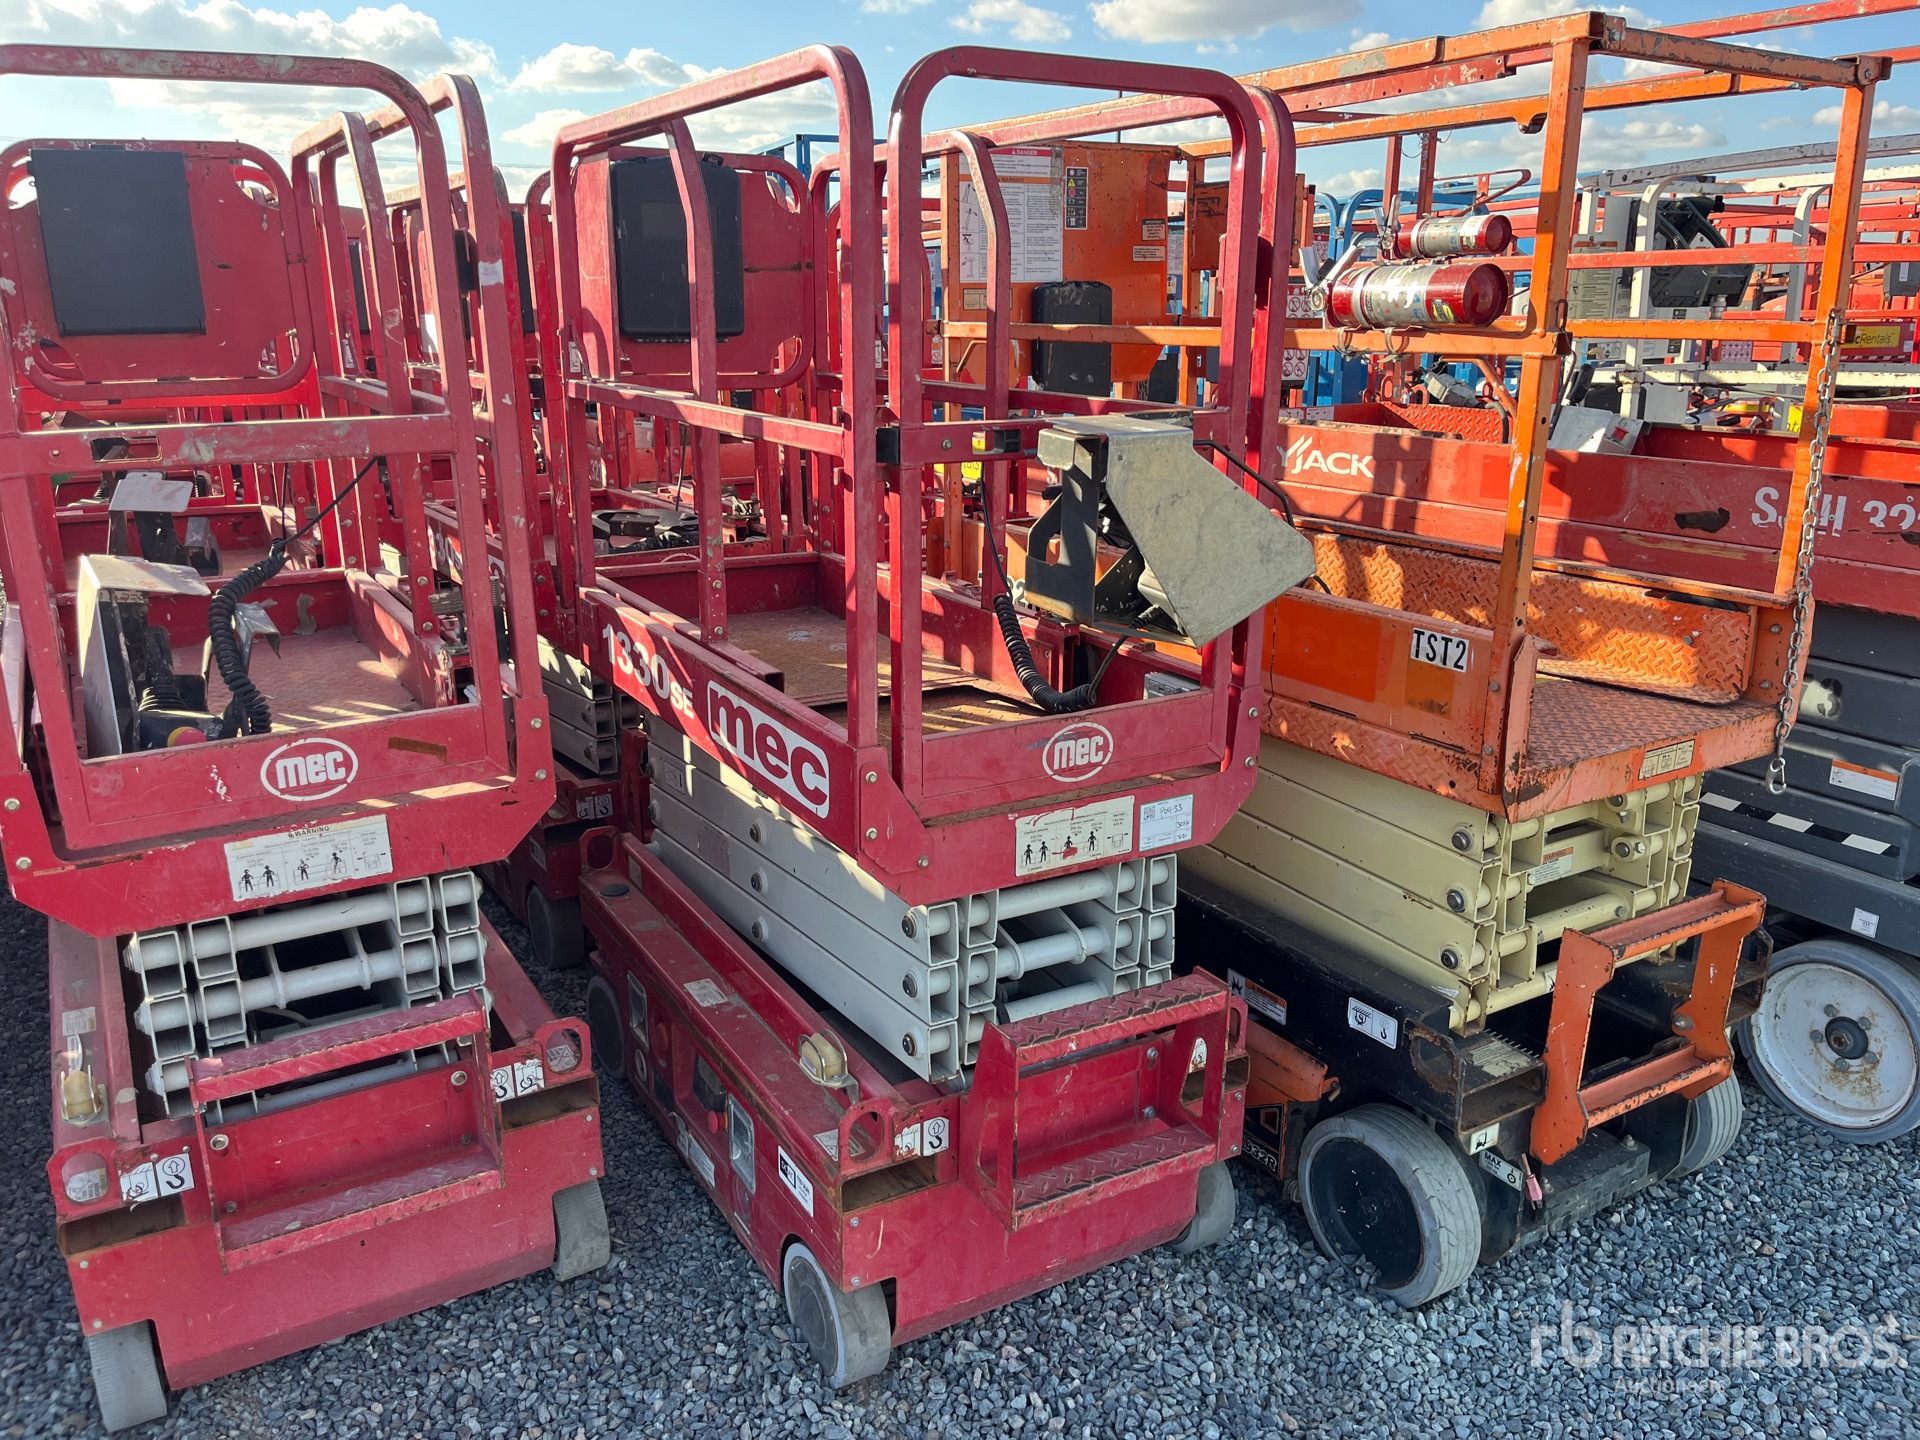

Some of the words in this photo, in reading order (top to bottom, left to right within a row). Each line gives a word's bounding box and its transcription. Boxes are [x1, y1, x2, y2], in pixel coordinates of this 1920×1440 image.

[1276, 434, 1375, 479] YJACK
[1413, 629, 1466, 670] TST2
[709, 684, 828, 807] mec
[1053, 735, 1104, 770] mec
[275, 750, 346, 789] mec
[294, 826, 330, 837] WARNING
[1484, 1151, 1501, 1167] MAX
